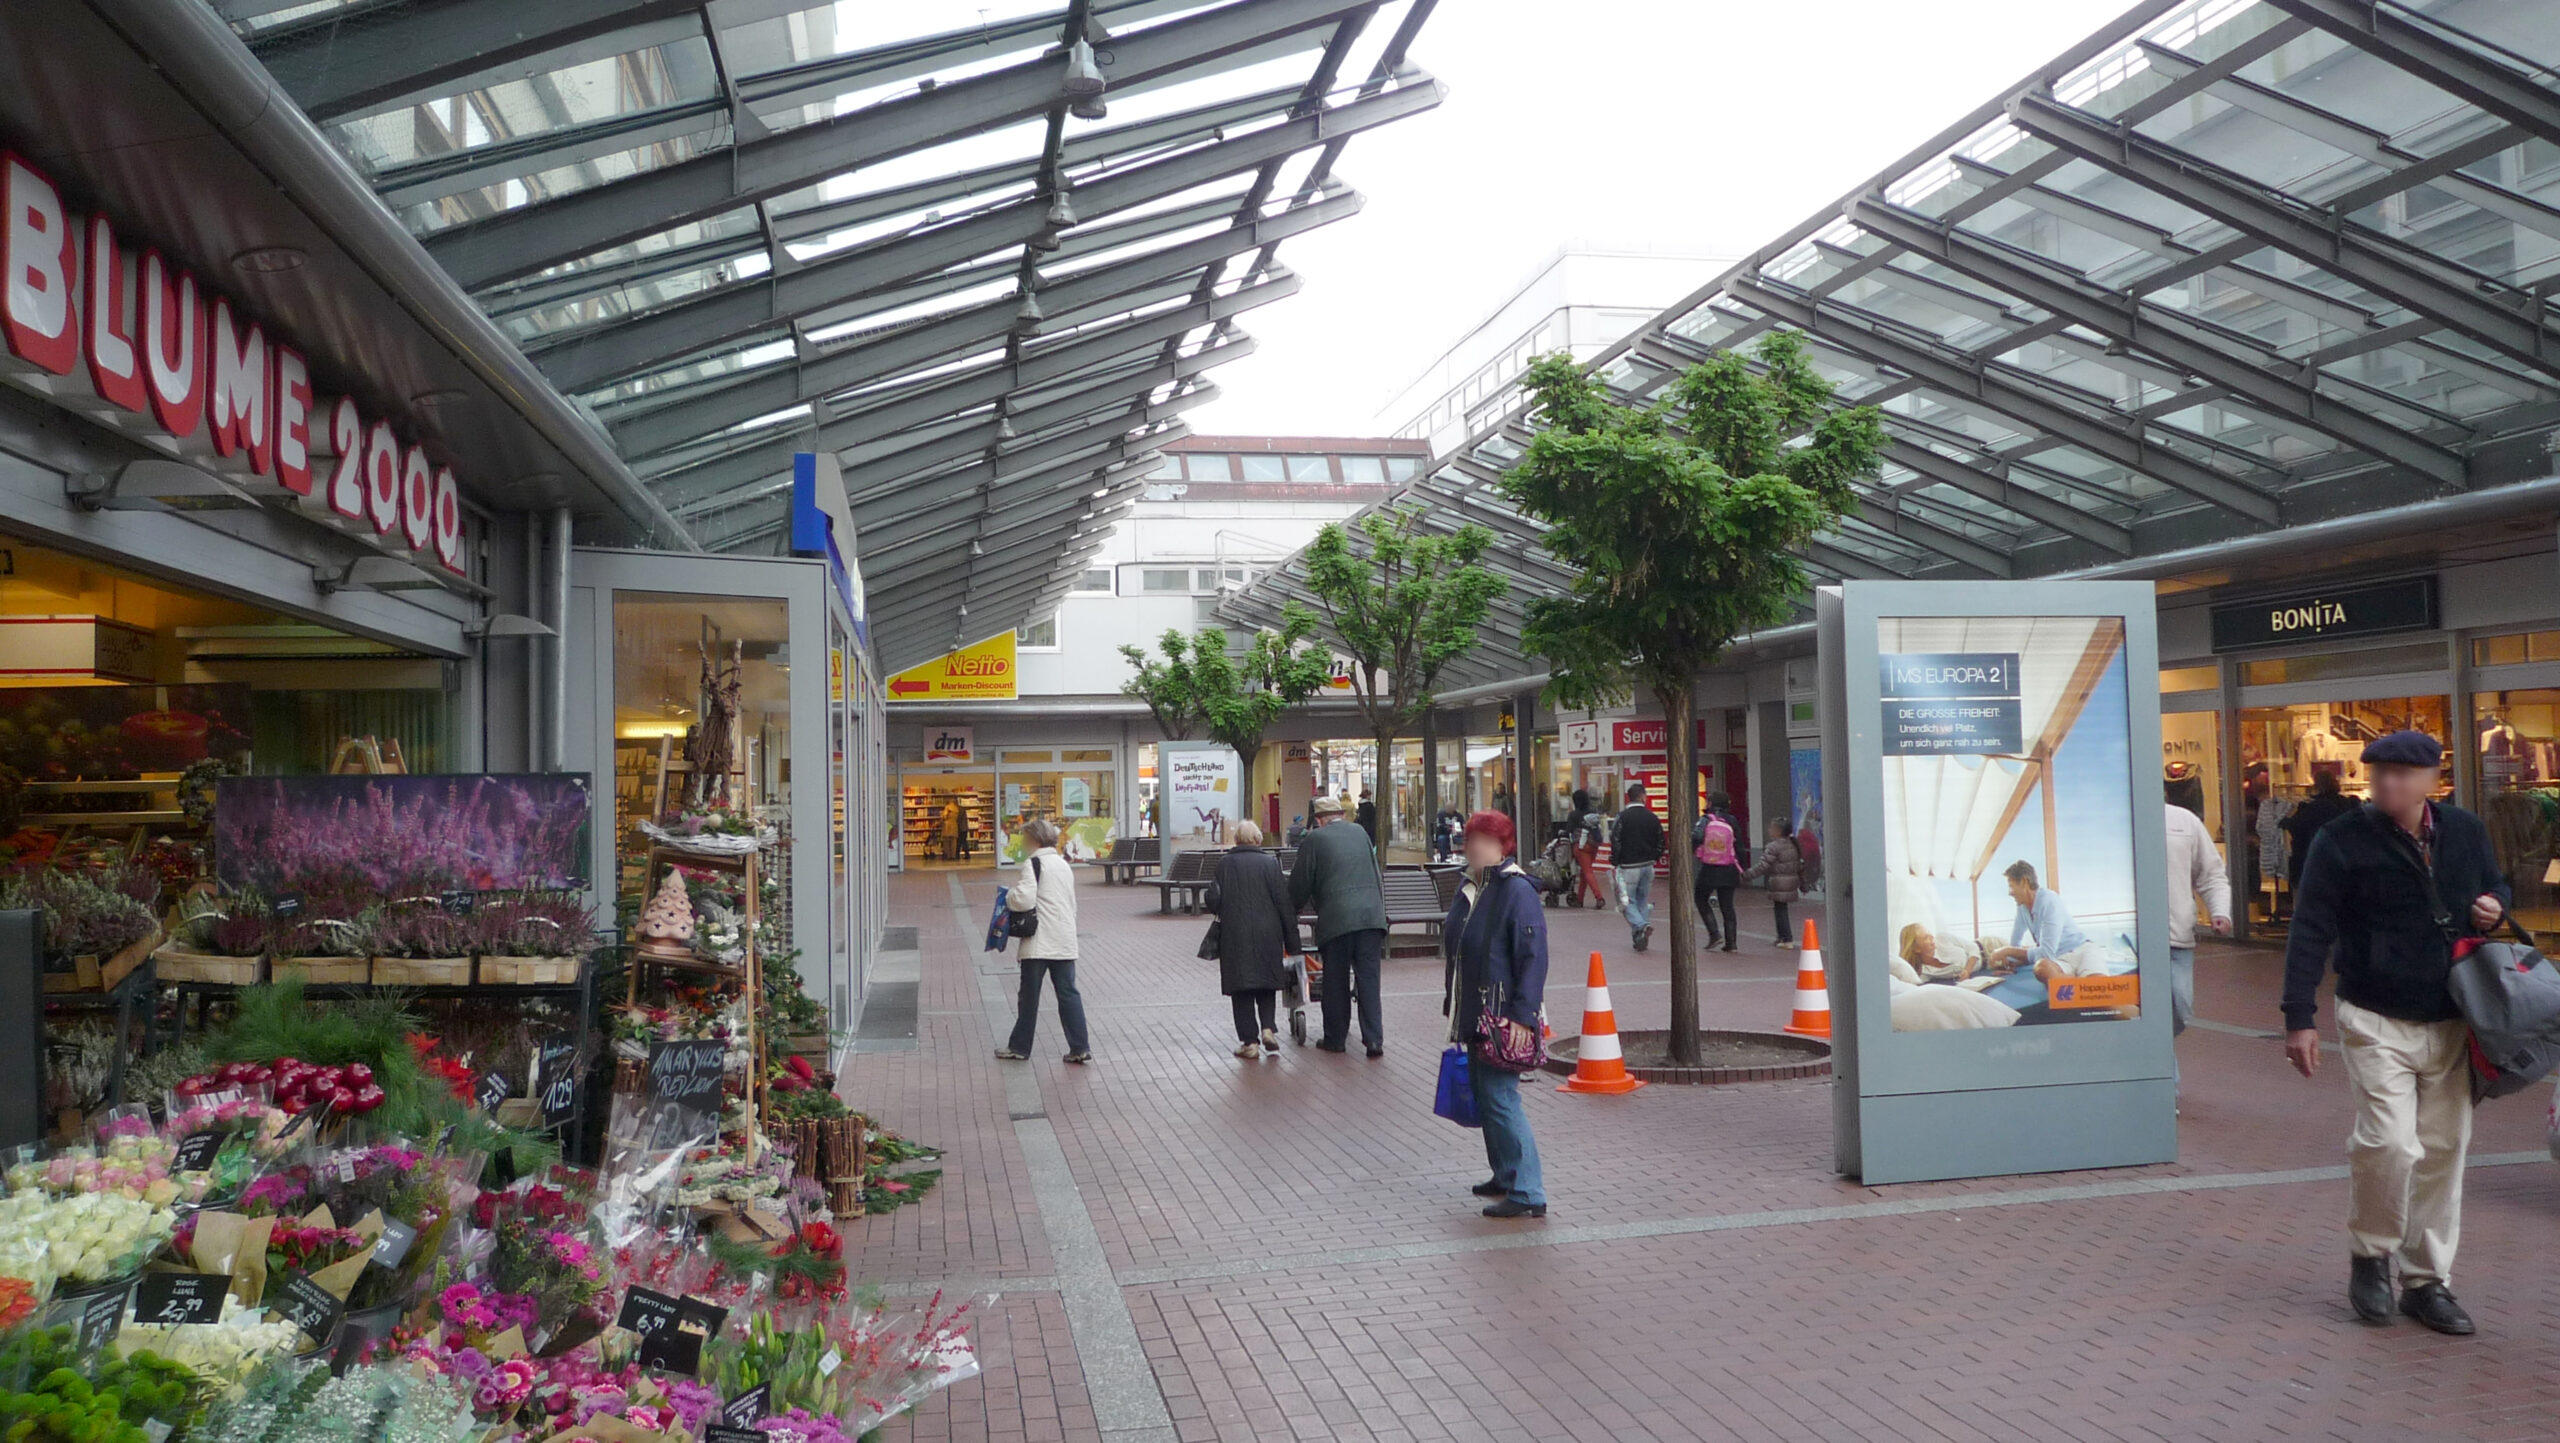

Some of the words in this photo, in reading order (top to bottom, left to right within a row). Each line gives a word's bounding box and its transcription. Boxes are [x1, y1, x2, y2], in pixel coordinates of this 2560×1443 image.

[2, 150, 314, 494] BLUME
[328, 394, 460, 568] 2000
[945, 653, 1010, 677] Netto
[1897, 668, 1921, 683] MS
[1925, 667, 1987, 683] EUROPA
[1989, 667, 2001, 683] 2
[941, 682, 1014, 690] Marken-Discount
[1898, 708, 1915, 719] DIE
[1916, 708, 1957, 719] GROSSE
[1899, 724, 1938, 733] Unendlich
[935, 732, 965, 750] dm
[1915, 739, 1932, 748] sich
[1933, 739, 1953, 750] ganz
[1954, 738, 1970, 747] nah
[1288, 745, 1307, 757] dm
[2080, 982, 2130, 993] Hapag-Lloyd
